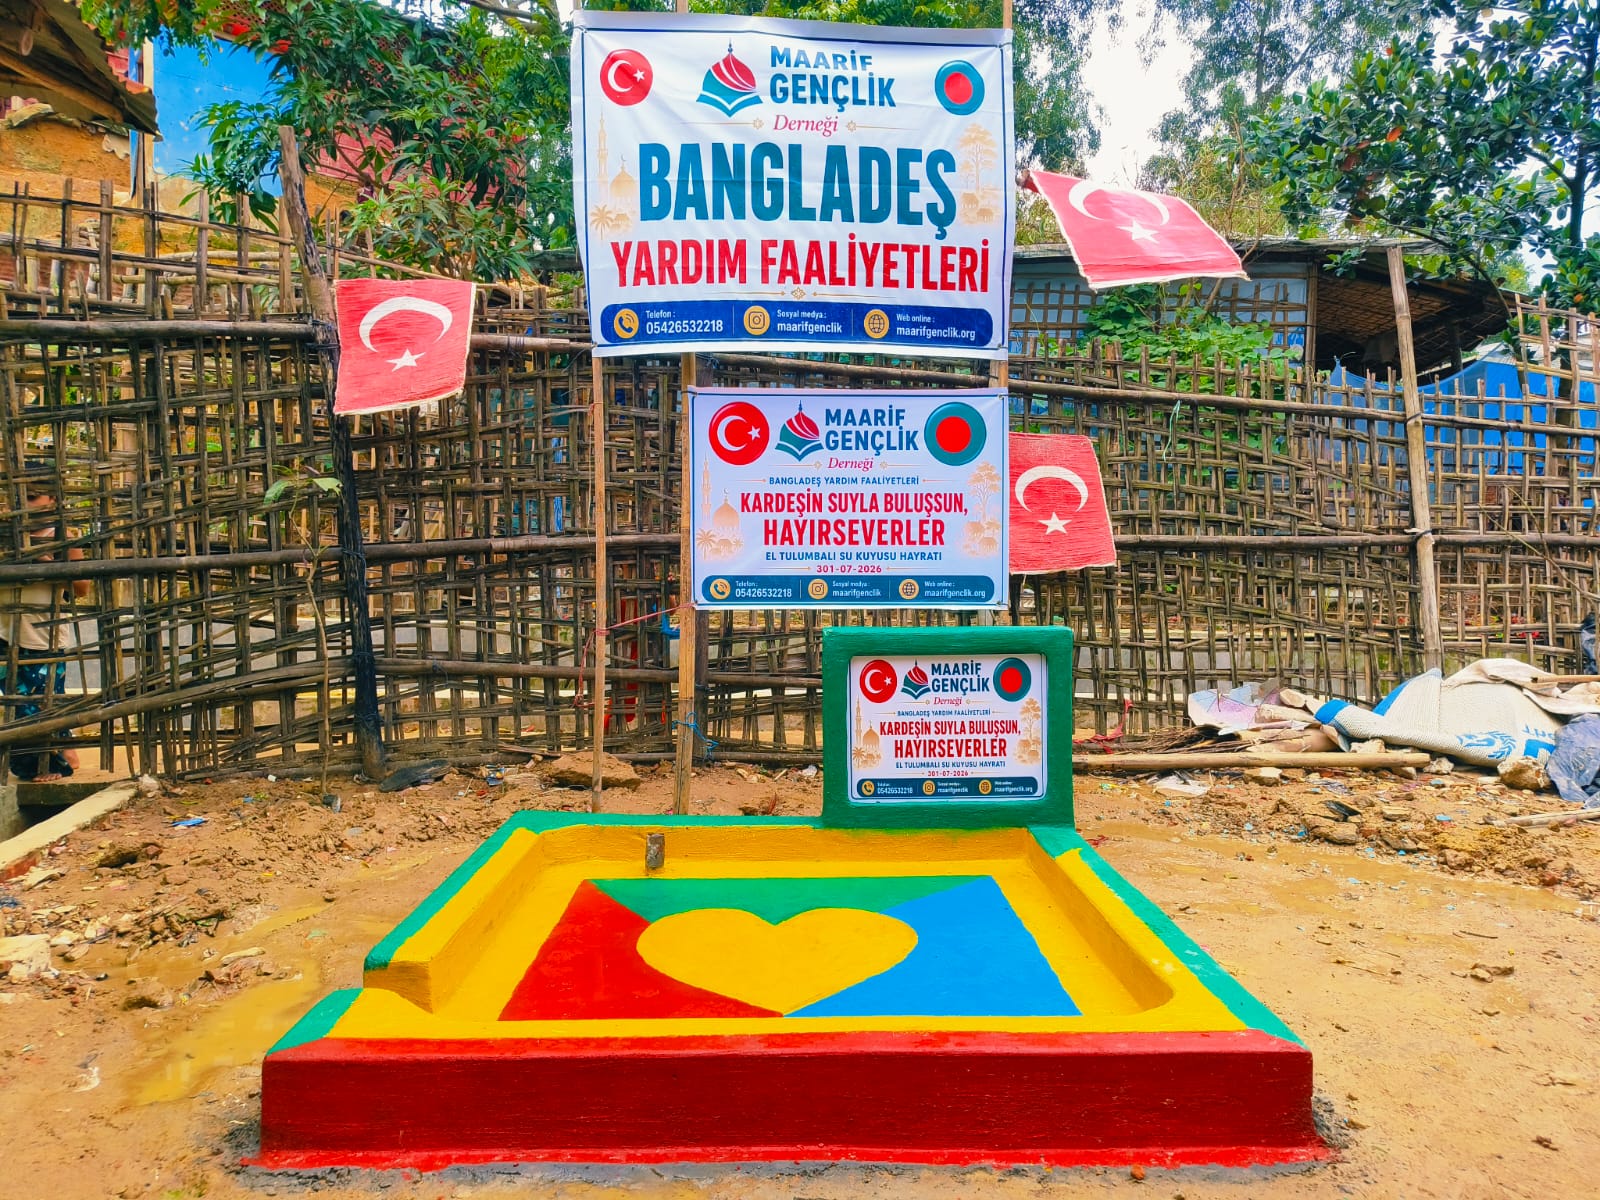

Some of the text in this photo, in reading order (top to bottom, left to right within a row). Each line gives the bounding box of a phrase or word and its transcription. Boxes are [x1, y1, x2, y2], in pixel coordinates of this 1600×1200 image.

[770, 45, 873, 70] MAARİF
[769, 72, 896, 113] GENÇLİK
[773, 114, 839, 137] Derneği
[639, 142, 957, 240] BANGLADEŞ
[610, 233, 990, 293] YARDIM FAALİYETLERİ
[777, 309, 799, 319] Sosyal
[896, 313, 910, 322] Web
[646, 319, 723, 335] 05426532218
[777, 321, 842, 335] maarifgenclik
[896, 325, 976, 340] maarifgenclik.org
[825, 404, 906, 427] MAARİF
[825, 427, 919, 456] GENÇLİK
[827, 457, 874, 472] Derneği
[769, 475, 919, 487] BANGLADEŞ YARDIM FAALİYETLERİ
[740, 488, 968, 517] KARDEŞİN SUYLA BULUŞSUN,
[764, 519, 945, 546] HAYIRSEVERLER
[766, 551, 942, 561] EL TULUMBALI SU KUYUSU HAYRATI
[816, 564, 882, 573] 301-07-2026
[735, 588, 792, 598] 05426532218
[832, 588, 881, 598] maarifgenclik
[924, 588, 986, 598] maarifgenclik.org
[931, 660, 982, 676] MAARİF
[931, 675, 989, 695] GENÇLİK
[933, 697, 962, 706] Derneği
[880, 718, 1021, 738] KARDEŞİN SUYLA BULUŞSUN,
[895, 738, 1007, 758] HAYIRSEVERLER
